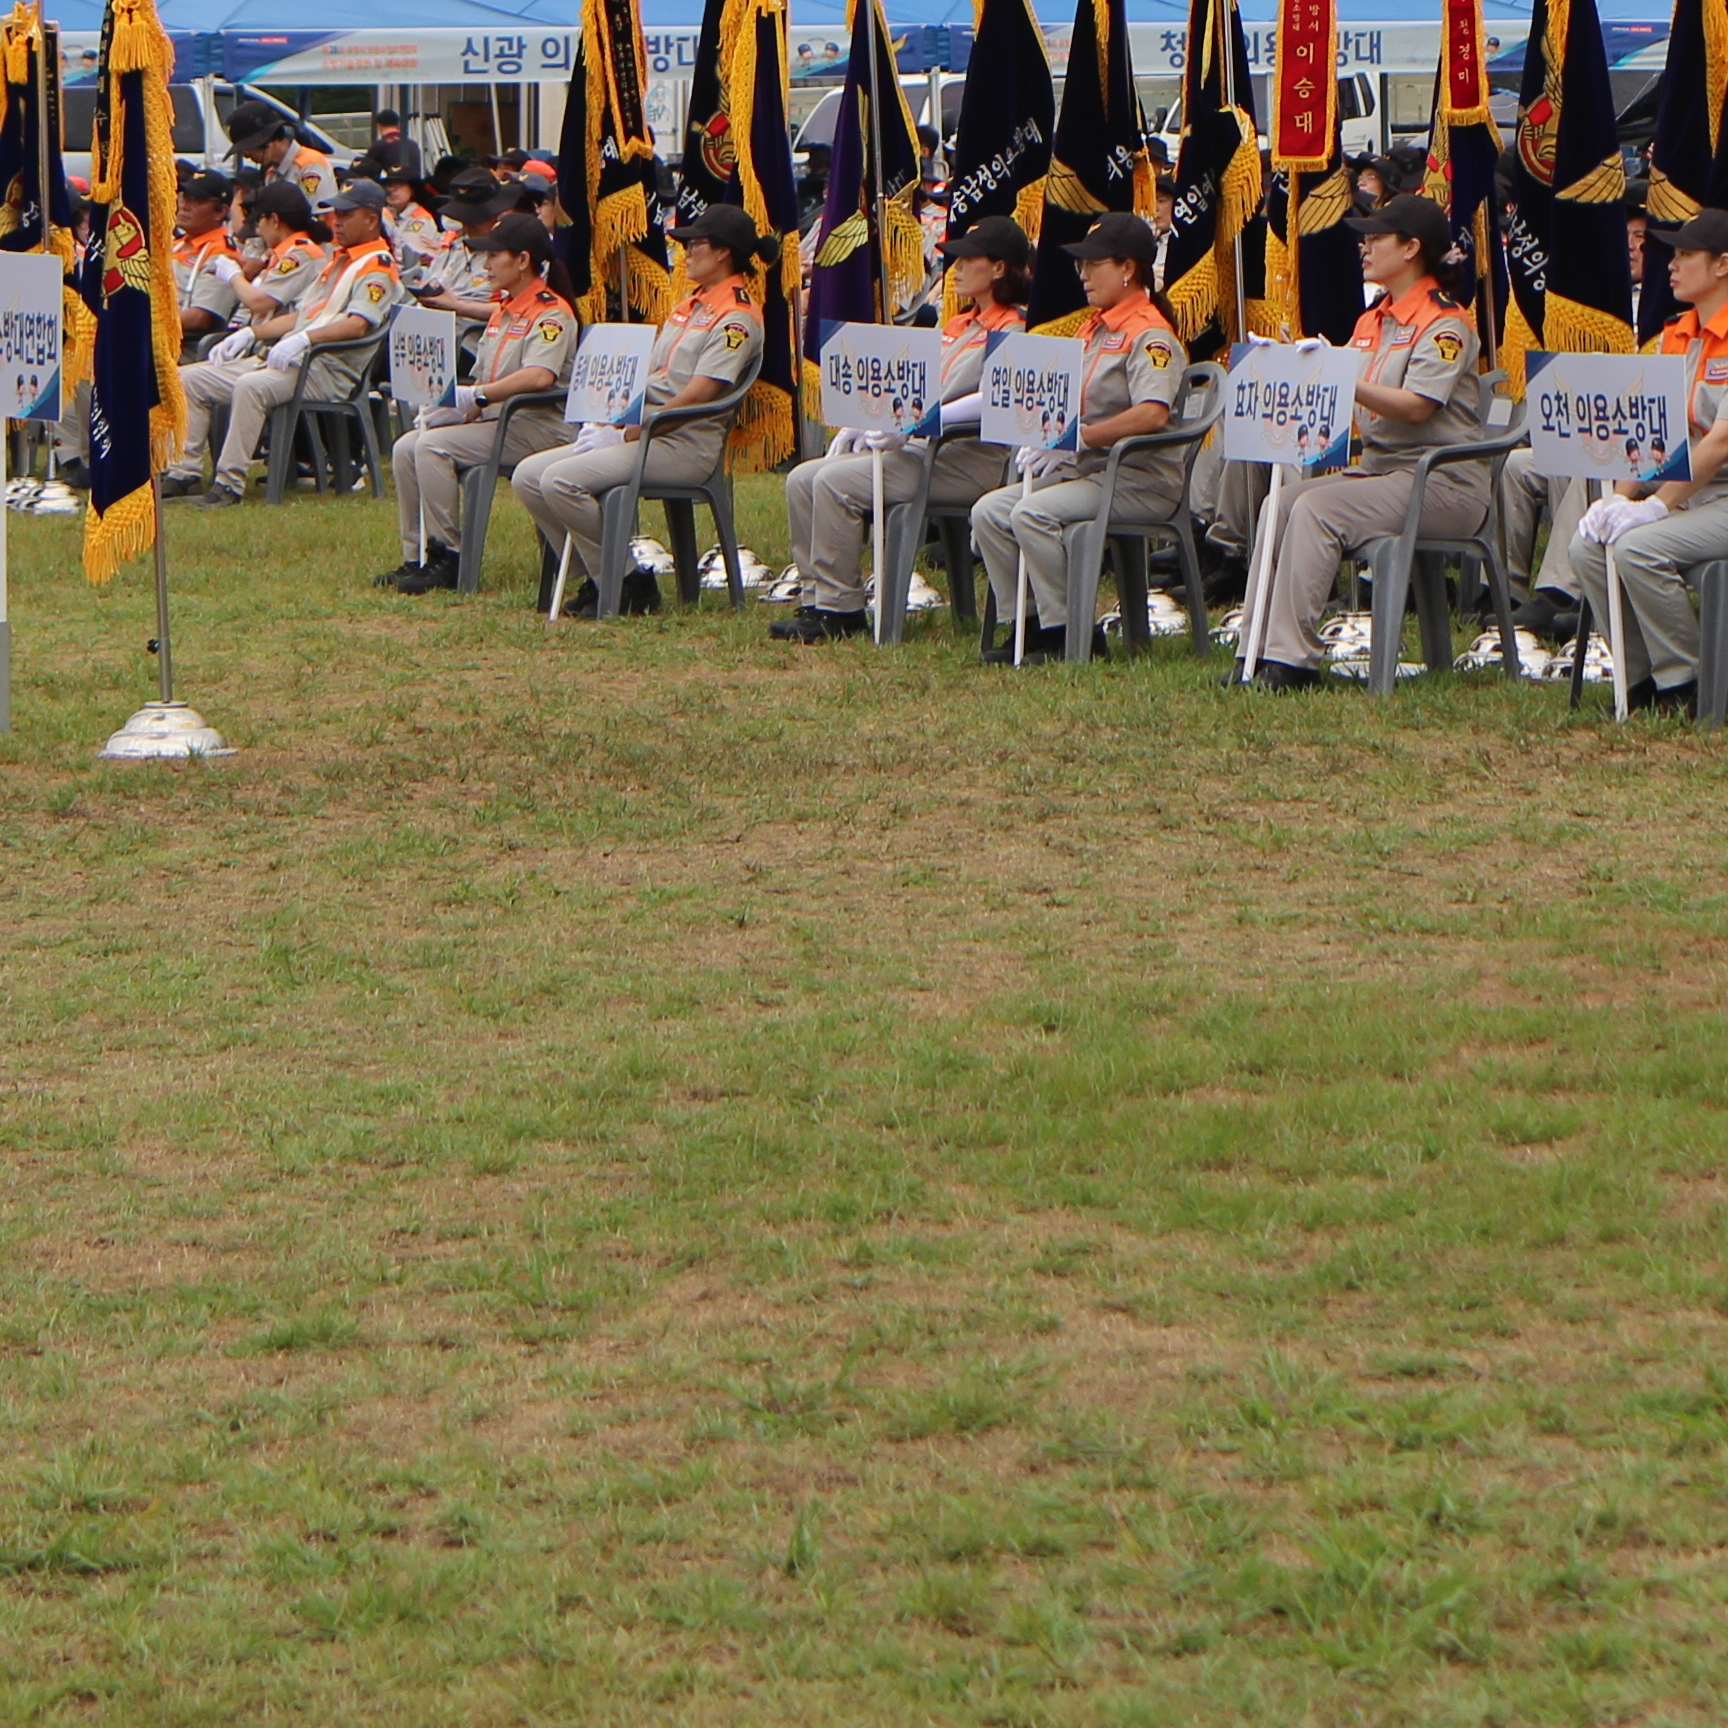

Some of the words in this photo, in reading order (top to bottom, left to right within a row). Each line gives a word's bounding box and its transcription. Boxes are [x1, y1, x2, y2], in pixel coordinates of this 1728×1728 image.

[460, 35, 528, 75] 신광
[393, 331, 407, 369] 남부
[408, 334, 446, 373] 의용소방대
[588, 352, 639, 393] 의용소방대
[829, 354, 853, 396] 대송
[856, 356, 927, 401] 의용소방대
[990, 366, 1012, 409] 연일
[1014, 368, 1070, 413] 의용소방대
[1234, 378, 1260, 422] 효자
[1261, 380, 1339, 428] 의용소방대
[1540, 390, 1571, 439] 오천
[1576, 393, 1669, 443] 의용소방대
